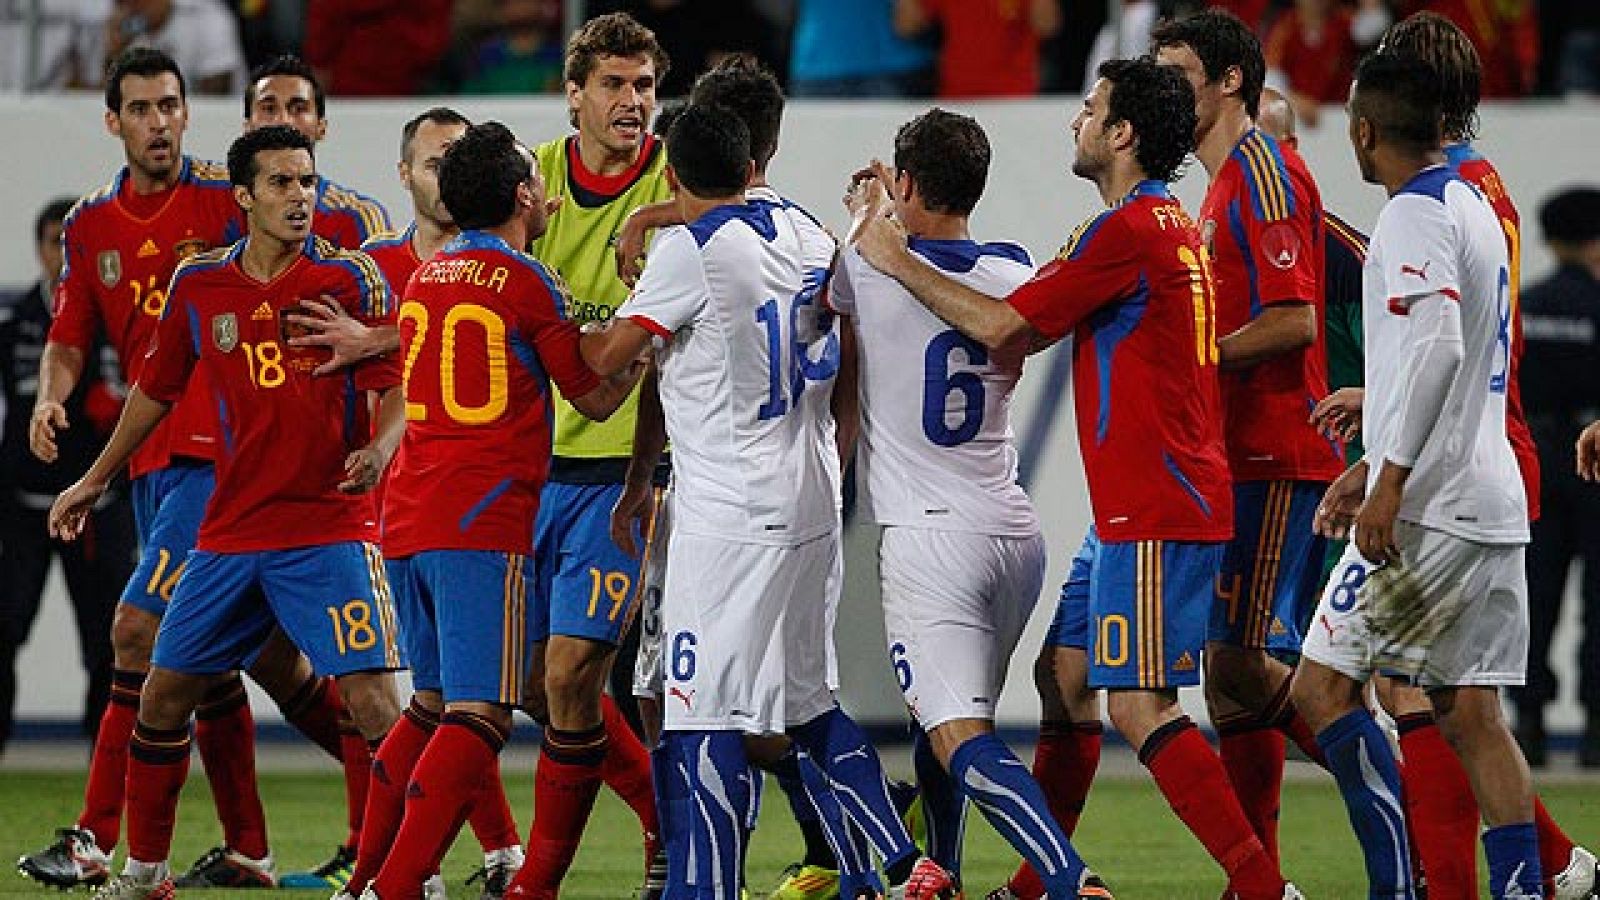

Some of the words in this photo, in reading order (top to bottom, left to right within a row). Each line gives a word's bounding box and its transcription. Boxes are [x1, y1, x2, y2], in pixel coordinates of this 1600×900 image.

[130, 275, 166, 317] 16
[241, 340, 286, 390] 18
[397, 300, 508, 424] 20
[922, 329, 988, 447] 6
[586, 567, 632, 622] 19
[1330, 562, 1366, 612] 8
[327, 599, 376, 656] 18
[662, 629, 697, 682] 6
